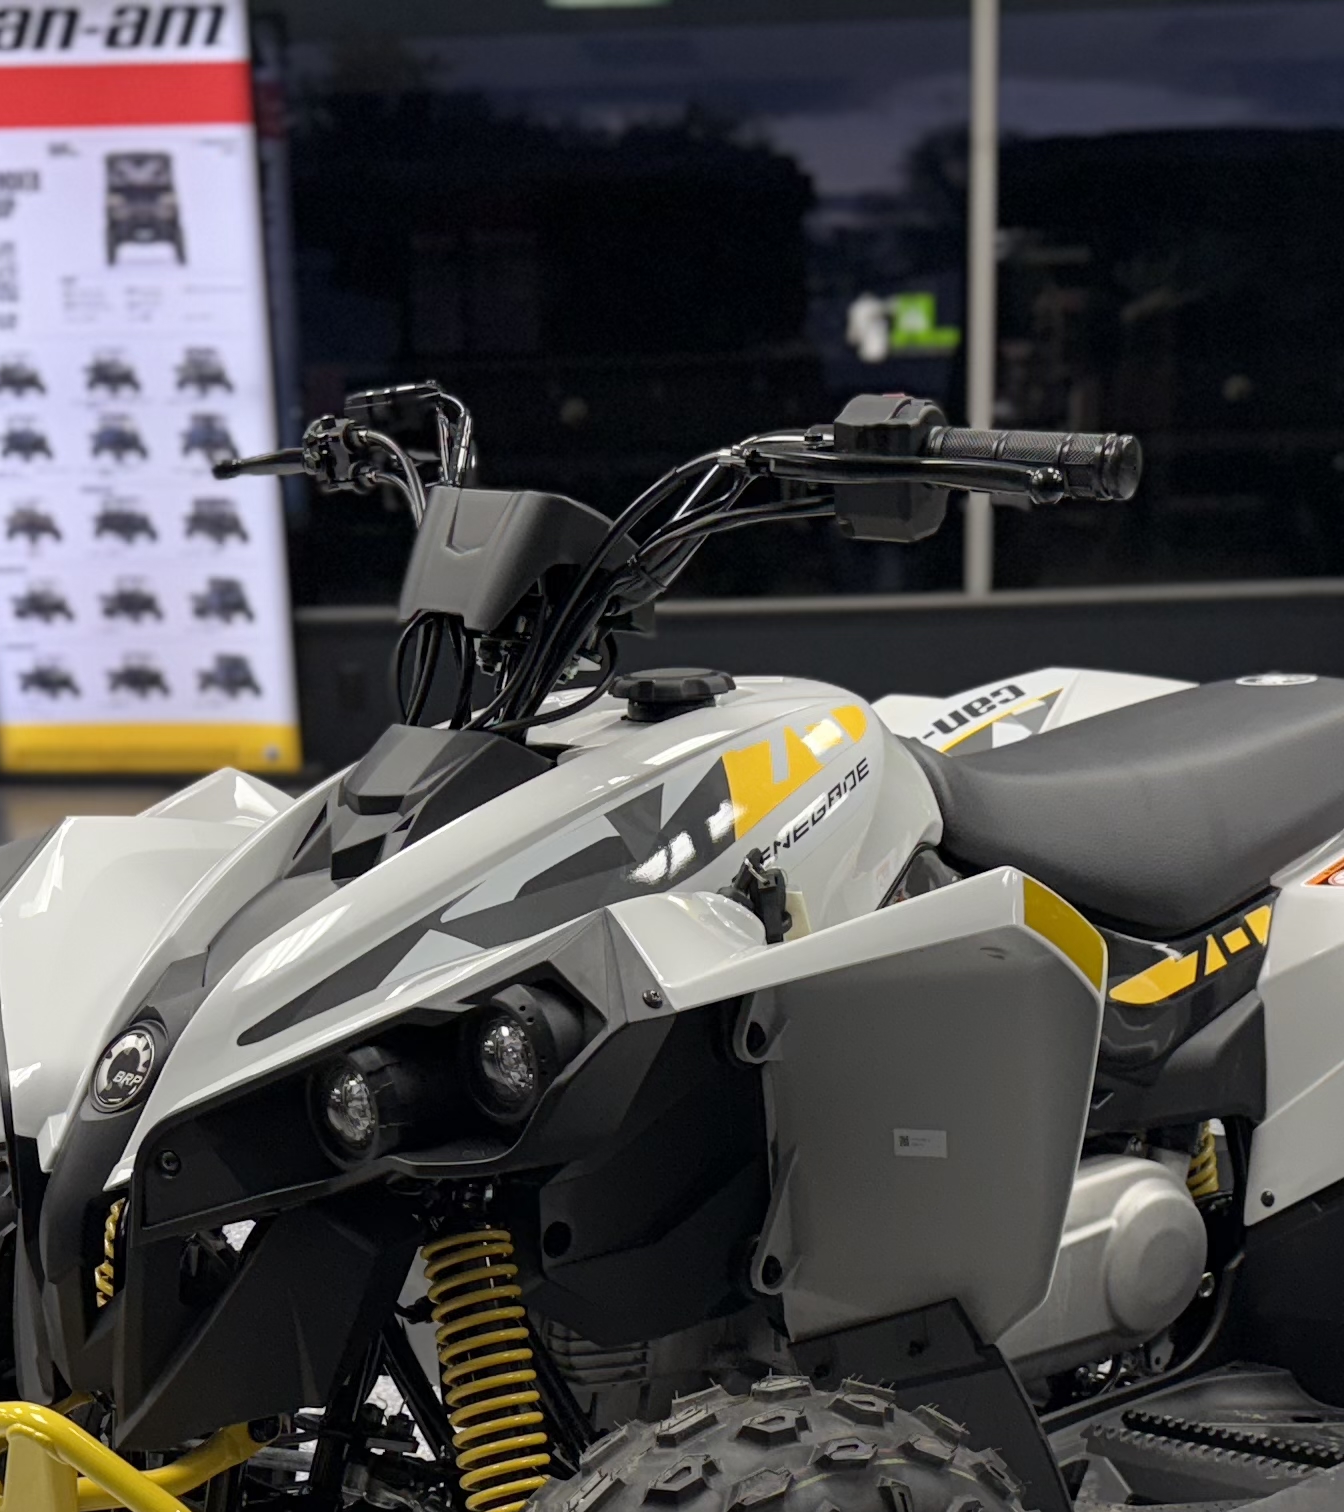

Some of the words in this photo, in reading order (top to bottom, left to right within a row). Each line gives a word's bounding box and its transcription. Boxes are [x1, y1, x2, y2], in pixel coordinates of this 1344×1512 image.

[922, 684, 1026, 740] can-
[759, 757, 870, 865] ENEGADE
[112, 1070, 143, 1087] BRP
